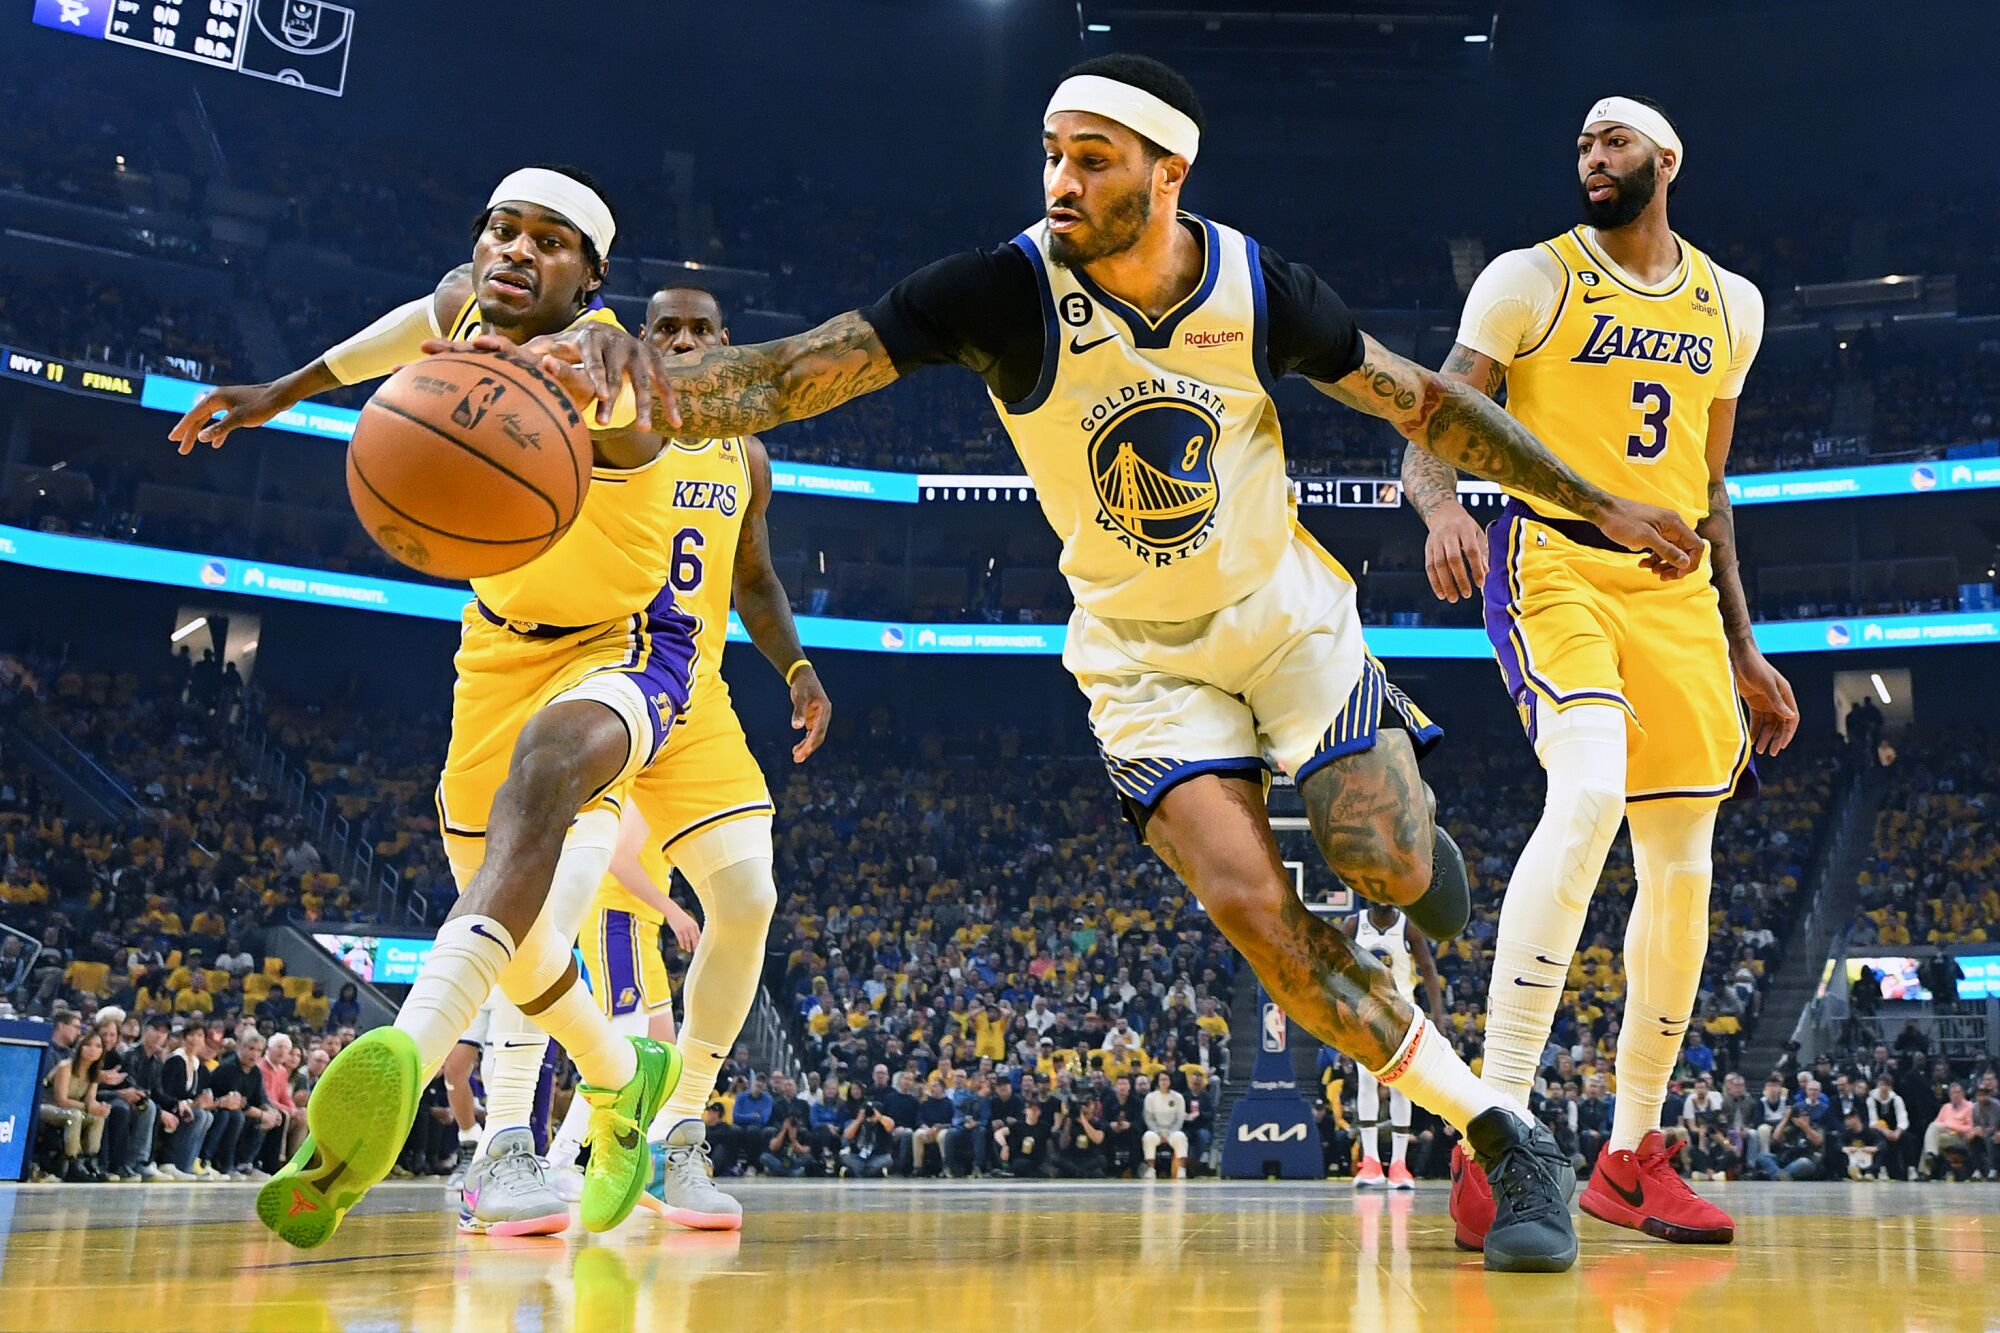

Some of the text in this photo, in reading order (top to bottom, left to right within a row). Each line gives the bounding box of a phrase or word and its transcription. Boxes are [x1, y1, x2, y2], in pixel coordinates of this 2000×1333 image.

[1580, 272, 1595, 286] 6
[1066, 297, 1086, 323] 6
[1690, 302, 1718, 317] bibigo
[1184, 330, 1244, 346] Rakuten
[1569, 314, 1714, 375] LAKERS
[82, 371, 133, 394] FINAL
[1081, 378, 1226, 432] GOLDEN STATE
[1625, 380, 1672, 463] 3
[1181, 435, 1204, 472] 8
[672, 480, 737, 517] KERS
[669, 527, 705, 595] 6
